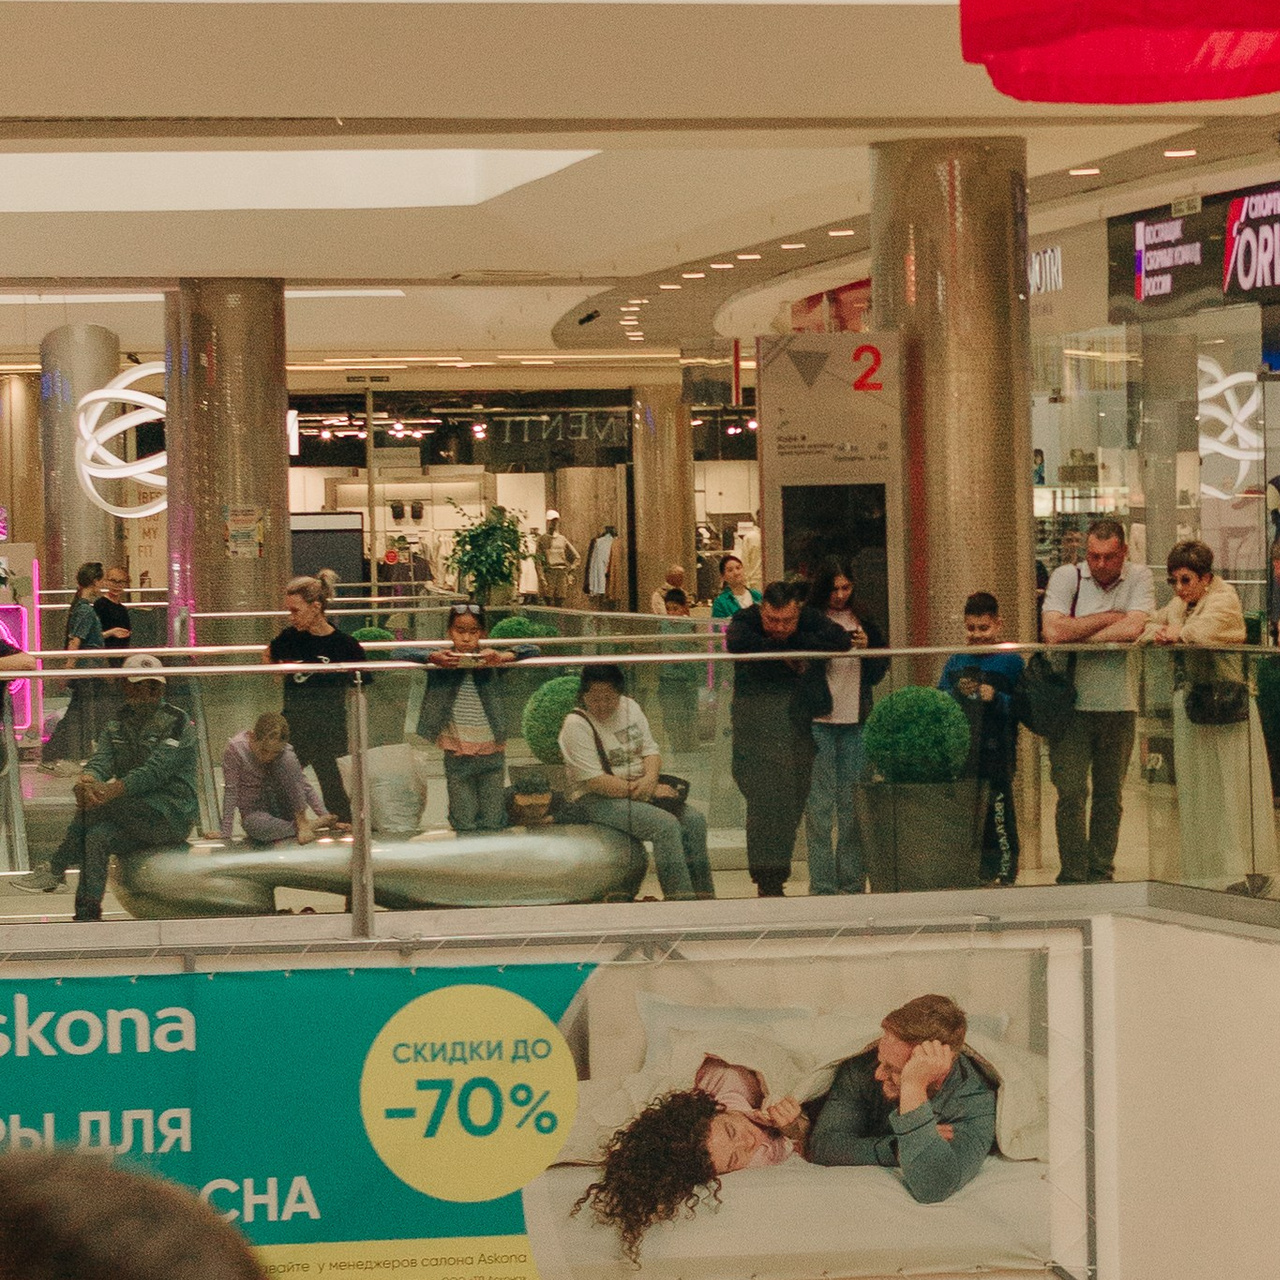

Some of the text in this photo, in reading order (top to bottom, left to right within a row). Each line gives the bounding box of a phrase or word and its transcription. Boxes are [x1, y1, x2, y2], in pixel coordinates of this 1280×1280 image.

[853, 344, 882, 391] 2
[392, 1038, 552, 1065] СКИДКИ ДО
[384, 1076, 558, 1139] -70%
[0, 1107, 192, 1162] Ы ДЛЯ
[200, 1175, 322, 1223] СНА
[317, 1263, 326, 1275] у
[329, 1258, 418, 1273] менеджеров
[421, 1254, 474, 1268] салона
[477, 1252, 528, 1266] Askona
